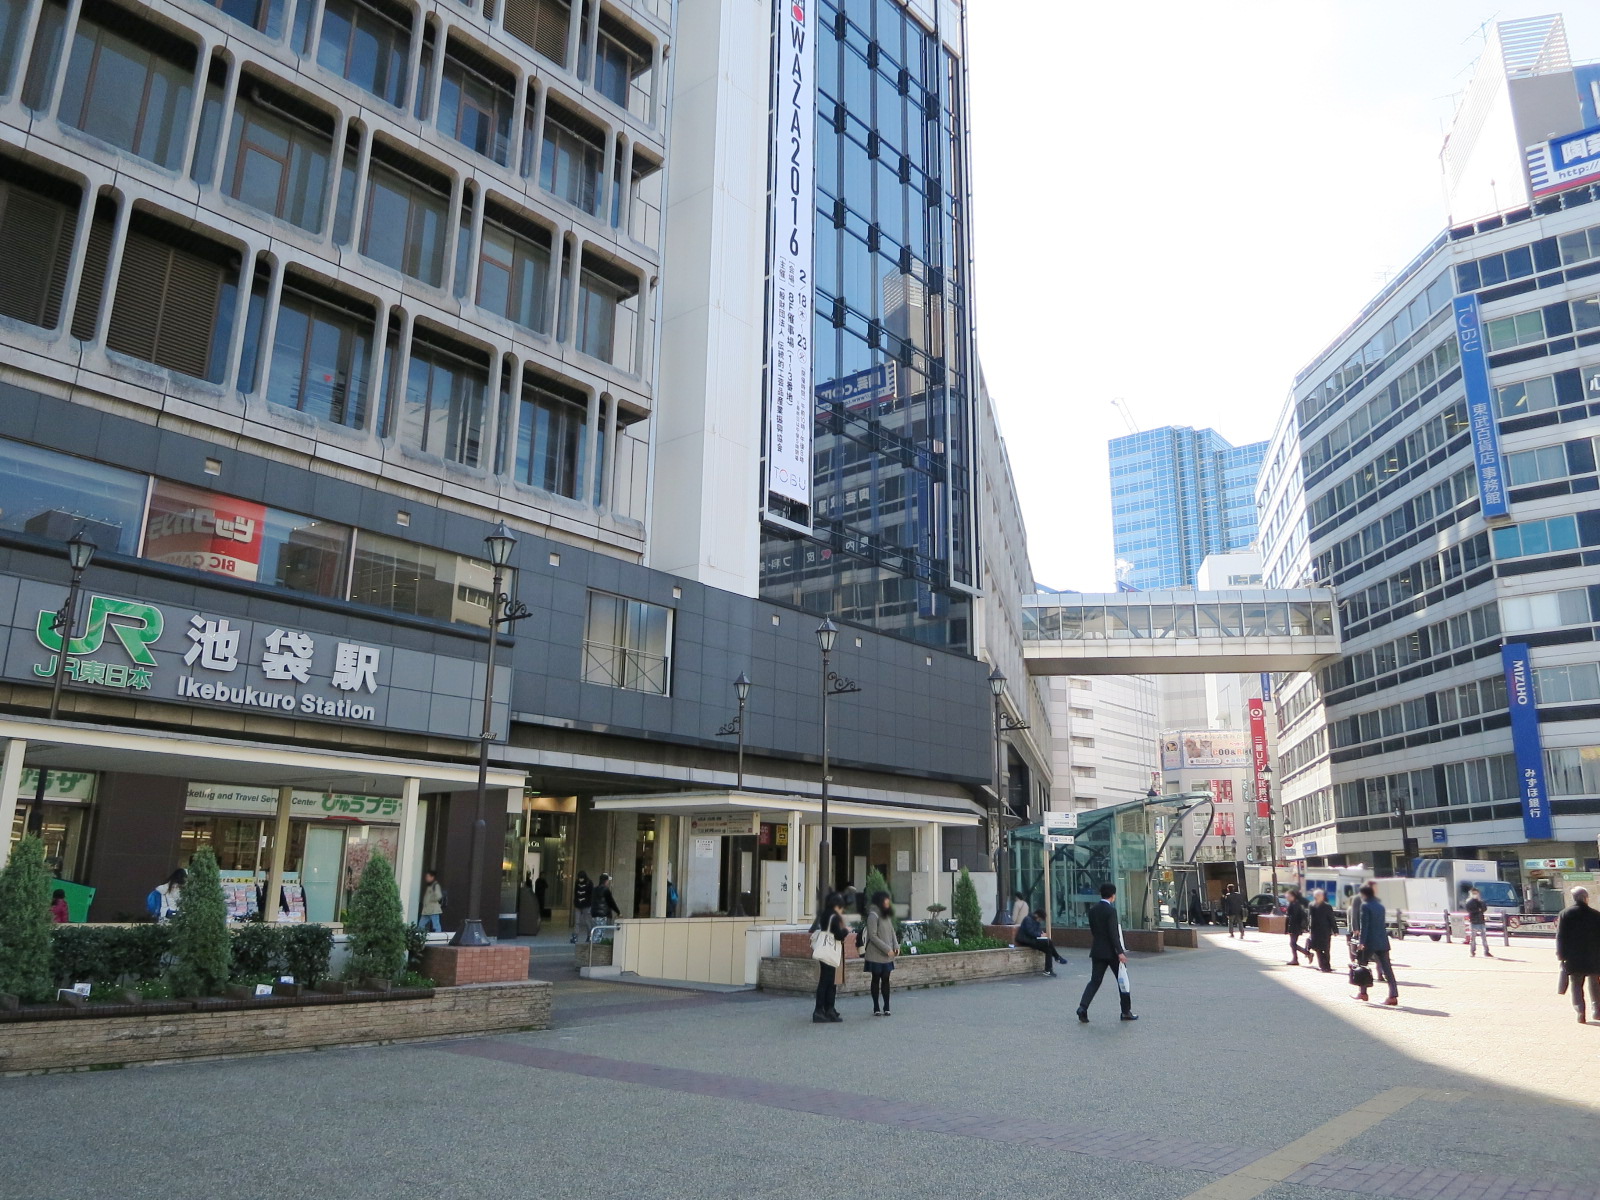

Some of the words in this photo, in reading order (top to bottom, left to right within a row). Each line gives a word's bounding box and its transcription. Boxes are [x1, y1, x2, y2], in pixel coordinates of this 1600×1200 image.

[790, 20, 806, 257] WAZA2016
[1458, 303, 1478, 352] TOBU
[1471, 402, 1495, 464] 東武百貨店
[774, 466, 806, 491] TOBU
[36, 595, 165, 667] JR
[184, 614, 381, 695] 池袋駅
[33, 655, 153, 690] JR東日本
[1512, 660, 1528, 705] MIZUHO
[177, 675, 296, 711] Ikebukuro
[300, 693, 376, 721] Station
[217, 793, 233, 801] and
[235, 792, 260, 803] Travel
[292, 797, 317, 806] Center
[321, 793, 402, 816] びゅうプラ
[1524, 769, 1542, 818] みずほ銀行
